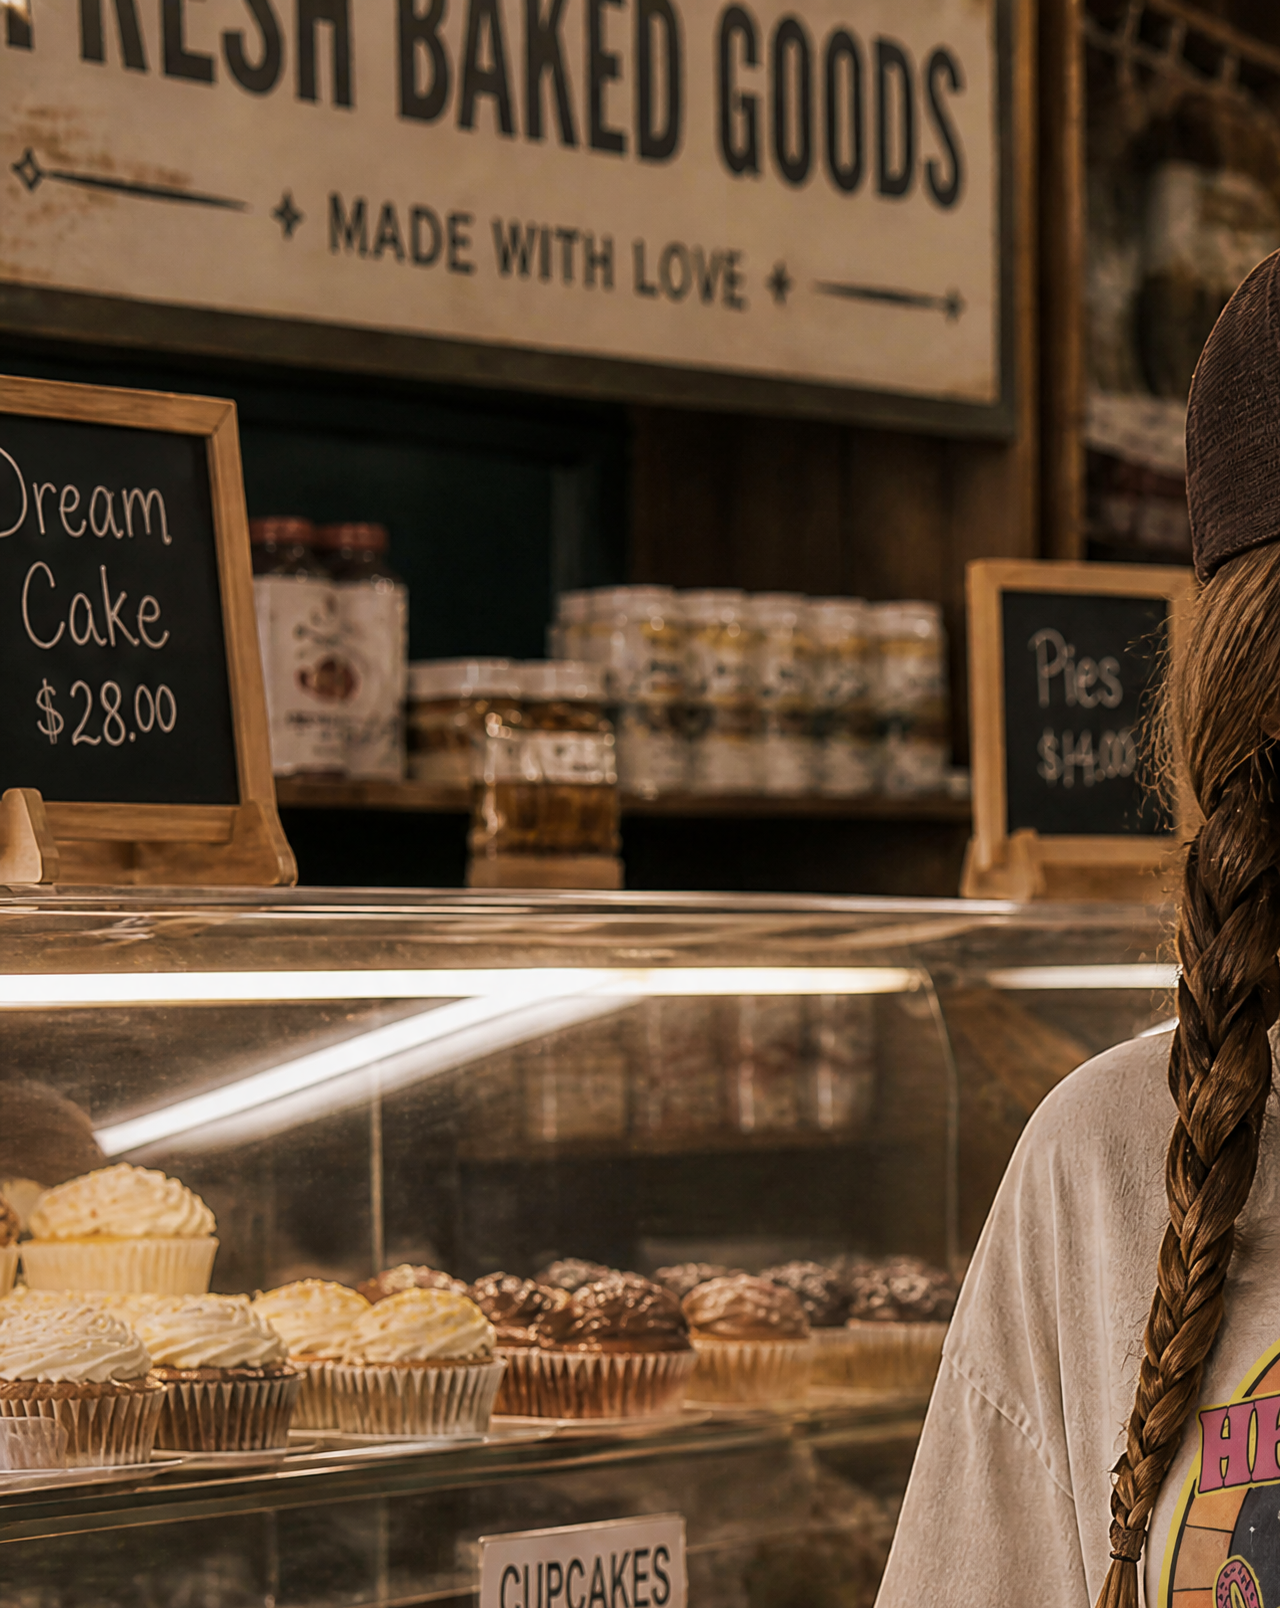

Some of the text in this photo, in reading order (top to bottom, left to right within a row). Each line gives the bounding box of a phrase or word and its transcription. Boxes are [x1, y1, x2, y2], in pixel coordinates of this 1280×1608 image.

[398, 0, 688, 166] BAKED
[715, 3, 967, 213] GOODS
[327, 192, 748, 312] MADE WITH LOVE
[21, 561, 170, 649] Cake
[1027, 627, 1124, 709] Pies
[36, 678, 177, 747] $28.00
[1036, 726, 1137, 788] $14.00
